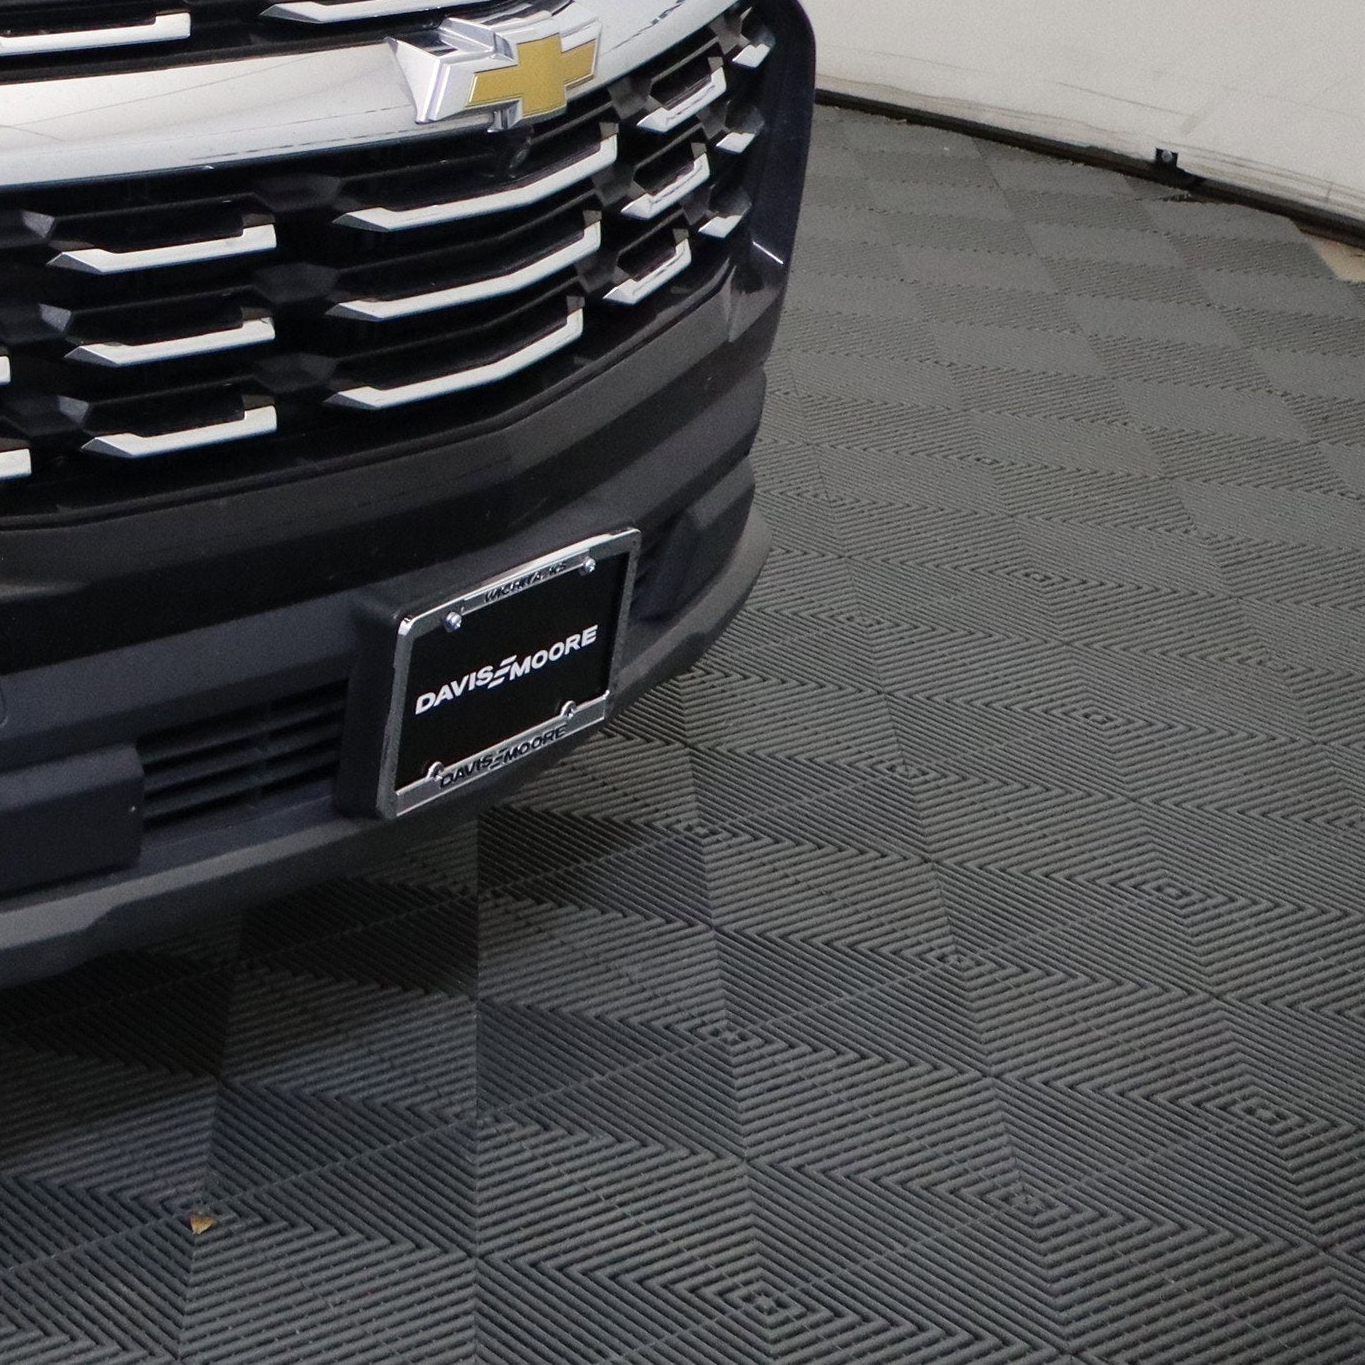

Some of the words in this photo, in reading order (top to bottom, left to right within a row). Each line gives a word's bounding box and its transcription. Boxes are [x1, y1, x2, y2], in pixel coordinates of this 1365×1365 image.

[414, 664, 495, 716] DAVIS
[508, 624, 599, 681] MOORE
[439, 753, 494, 789] DAVIS
[502, 722, 568, 763] MOORE
